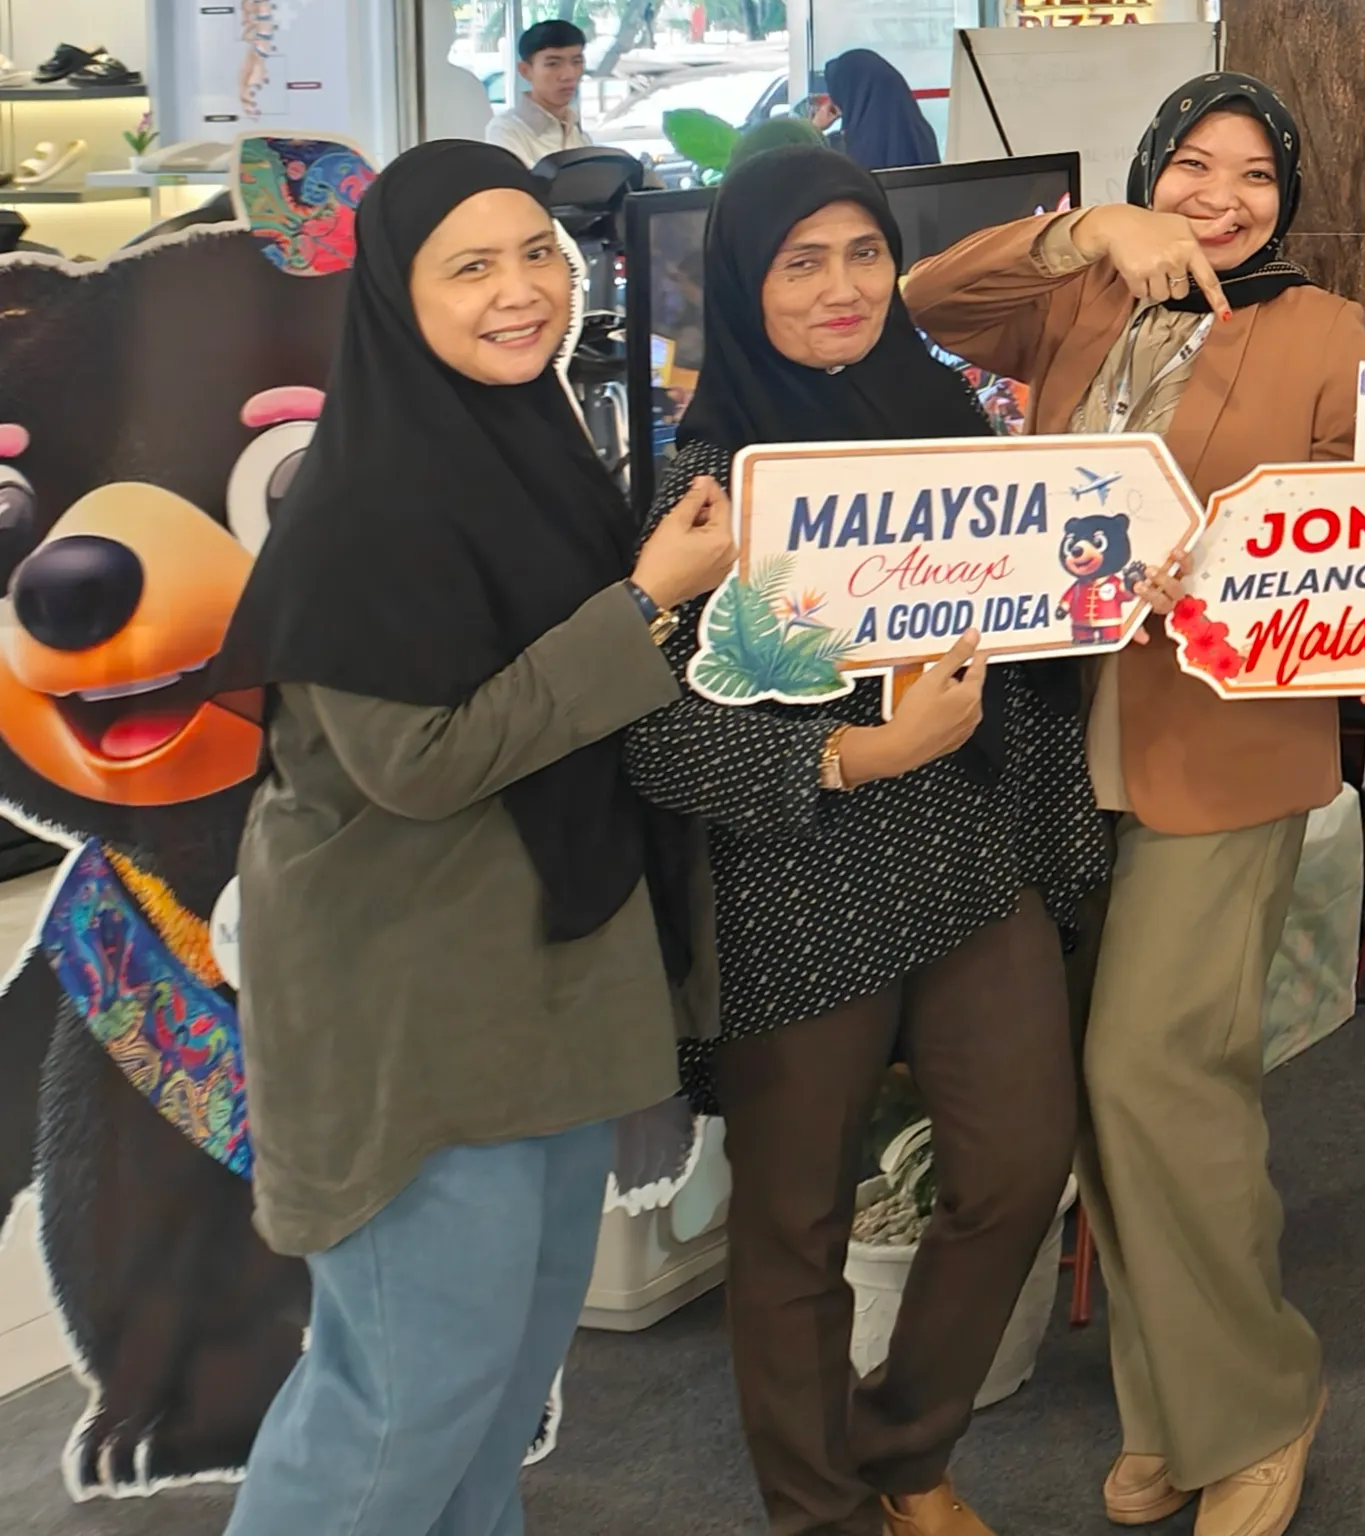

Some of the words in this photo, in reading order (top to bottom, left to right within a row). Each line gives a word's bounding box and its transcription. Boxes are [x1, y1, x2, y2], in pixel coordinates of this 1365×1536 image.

[787, 482, 1048, 551] MALAYSIA
[847, 544, 1015, 600] Always
[854, 606, 877, 644] A
[887, 600, 974, 640] GOOD
[981, 594, 1050, 634] IDEA
